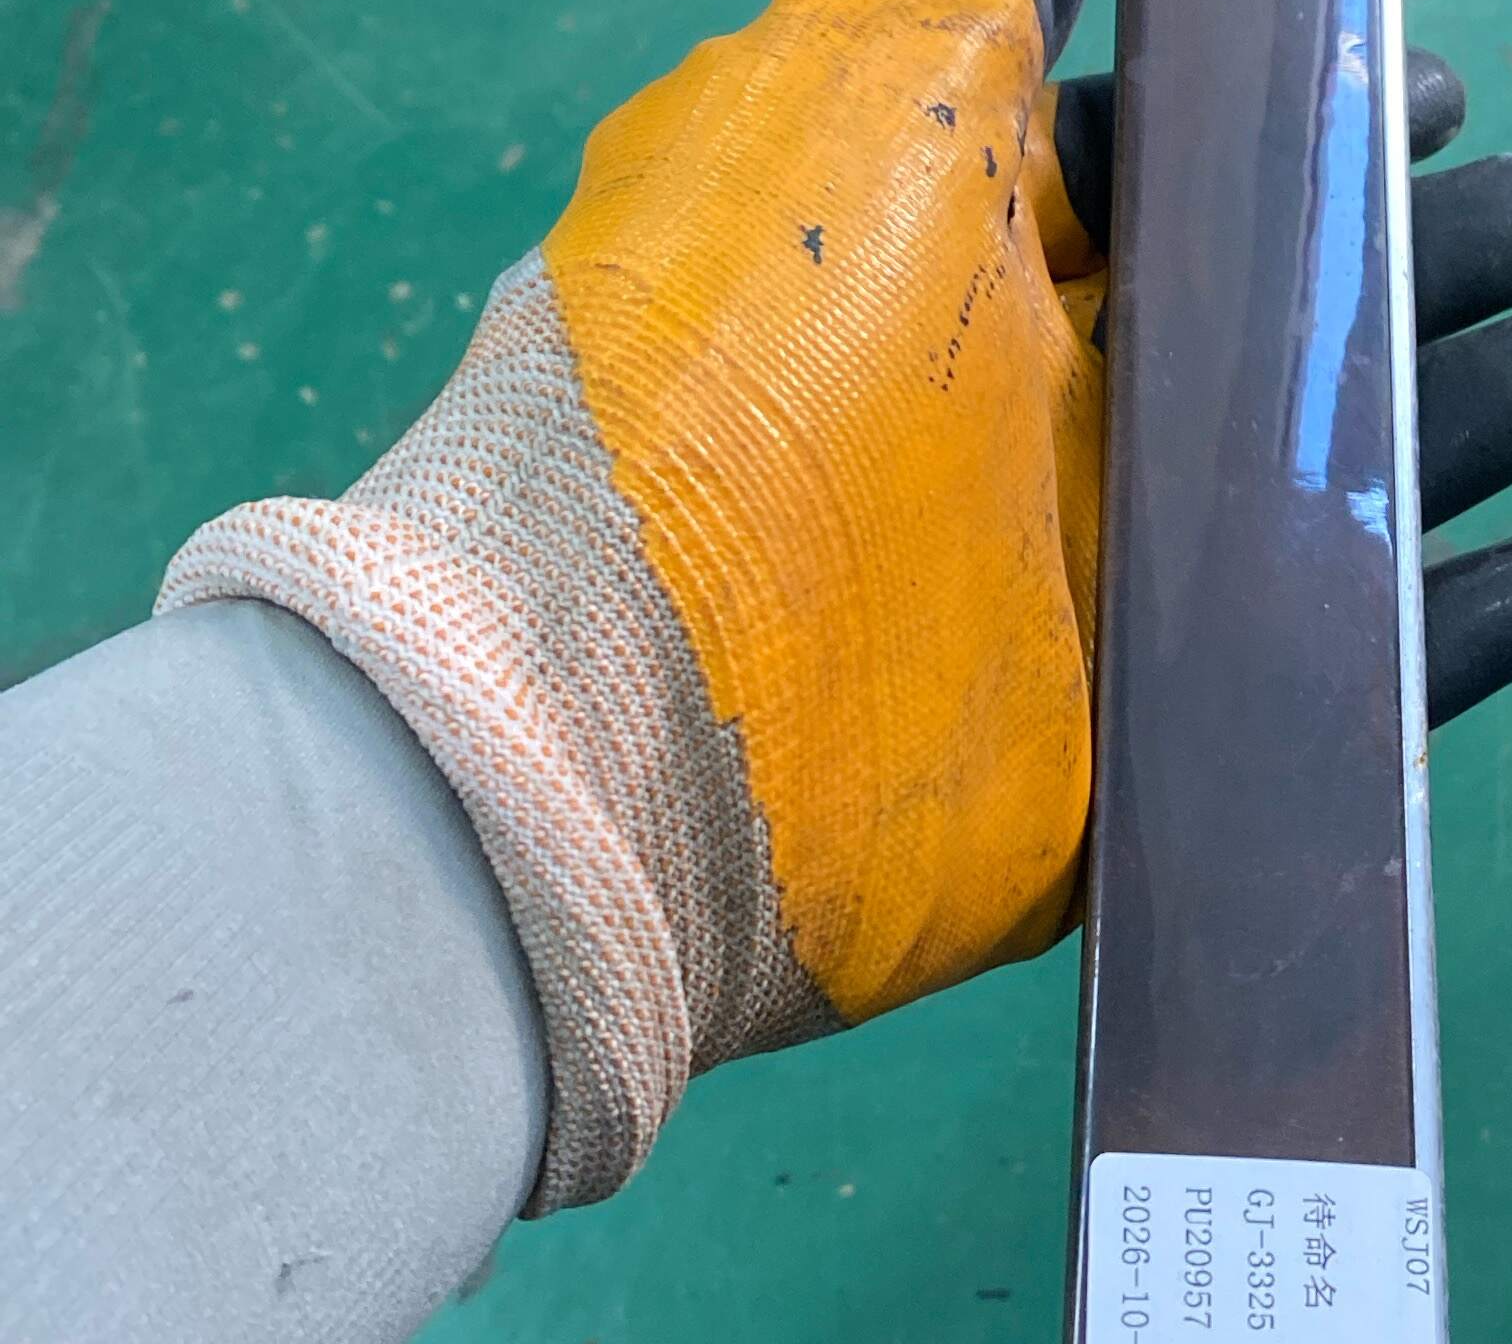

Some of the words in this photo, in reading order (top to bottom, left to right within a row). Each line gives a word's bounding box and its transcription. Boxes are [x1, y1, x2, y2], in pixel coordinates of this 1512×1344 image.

[1183, 1187, 1213, 1329] PU20957
[1243, 1189, 1275, 1331] GJ-3325
[1302, 1193, 1337, 1308] 待命名
[1401, 1197, 1431, 1296] WSJ07
